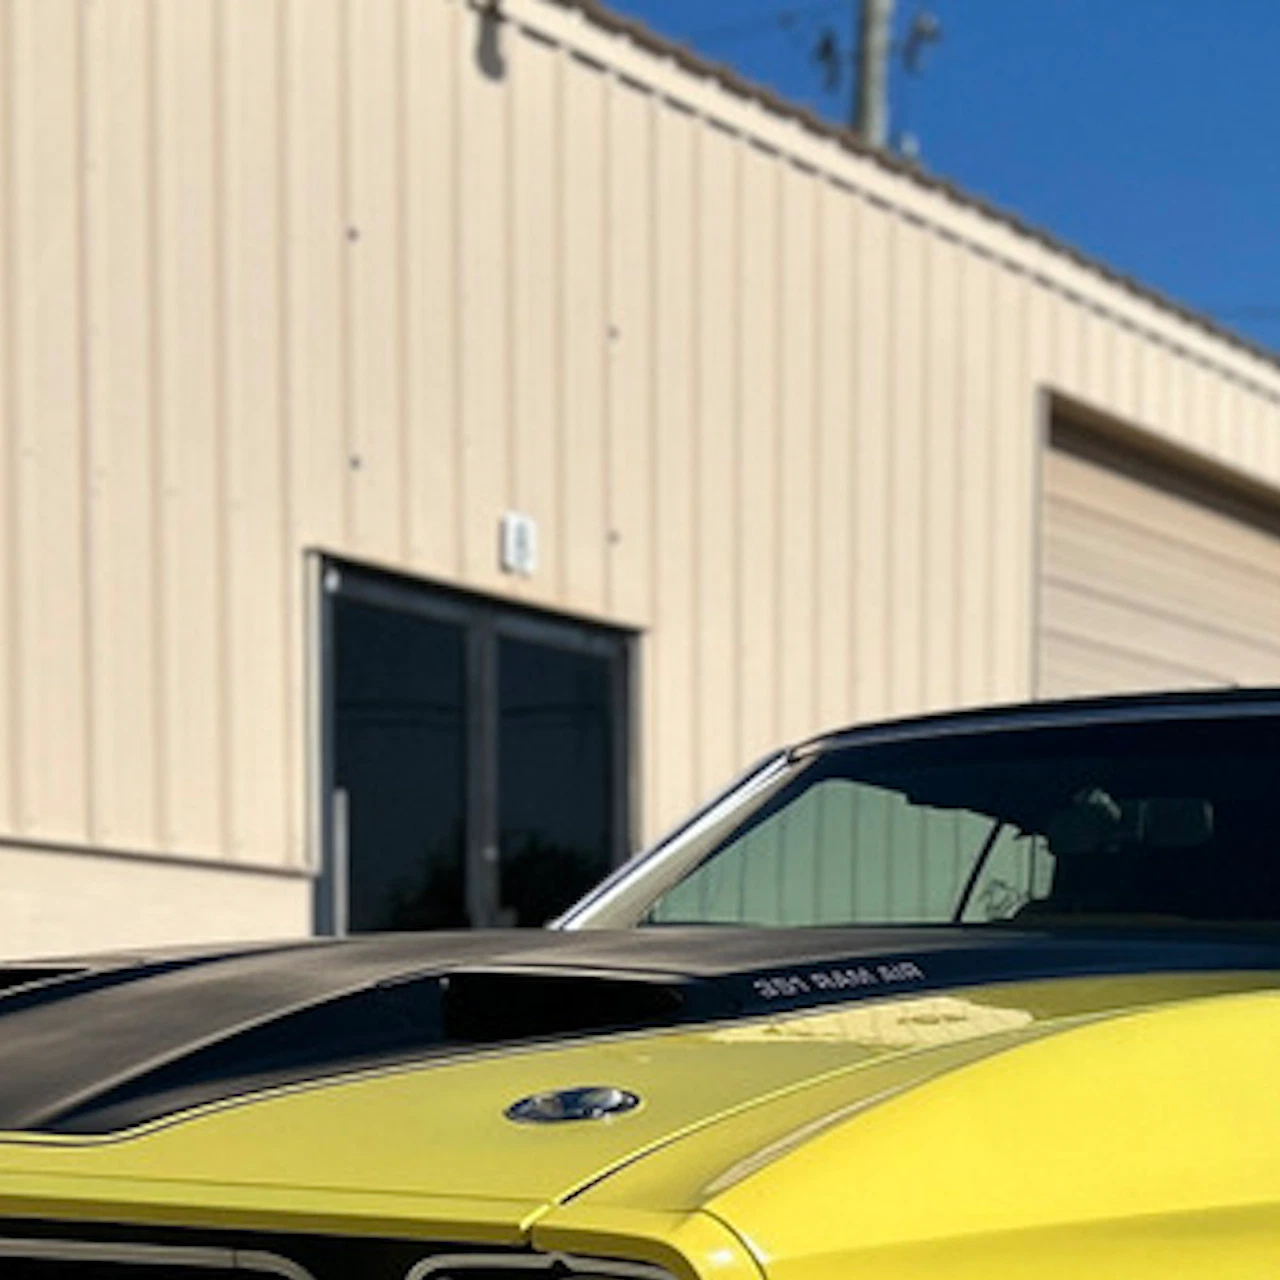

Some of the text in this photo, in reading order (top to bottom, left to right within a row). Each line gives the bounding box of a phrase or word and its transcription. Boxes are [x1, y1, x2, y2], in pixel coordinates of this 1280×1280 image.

[753, 961, 925, 999] 351 RAM AIR
